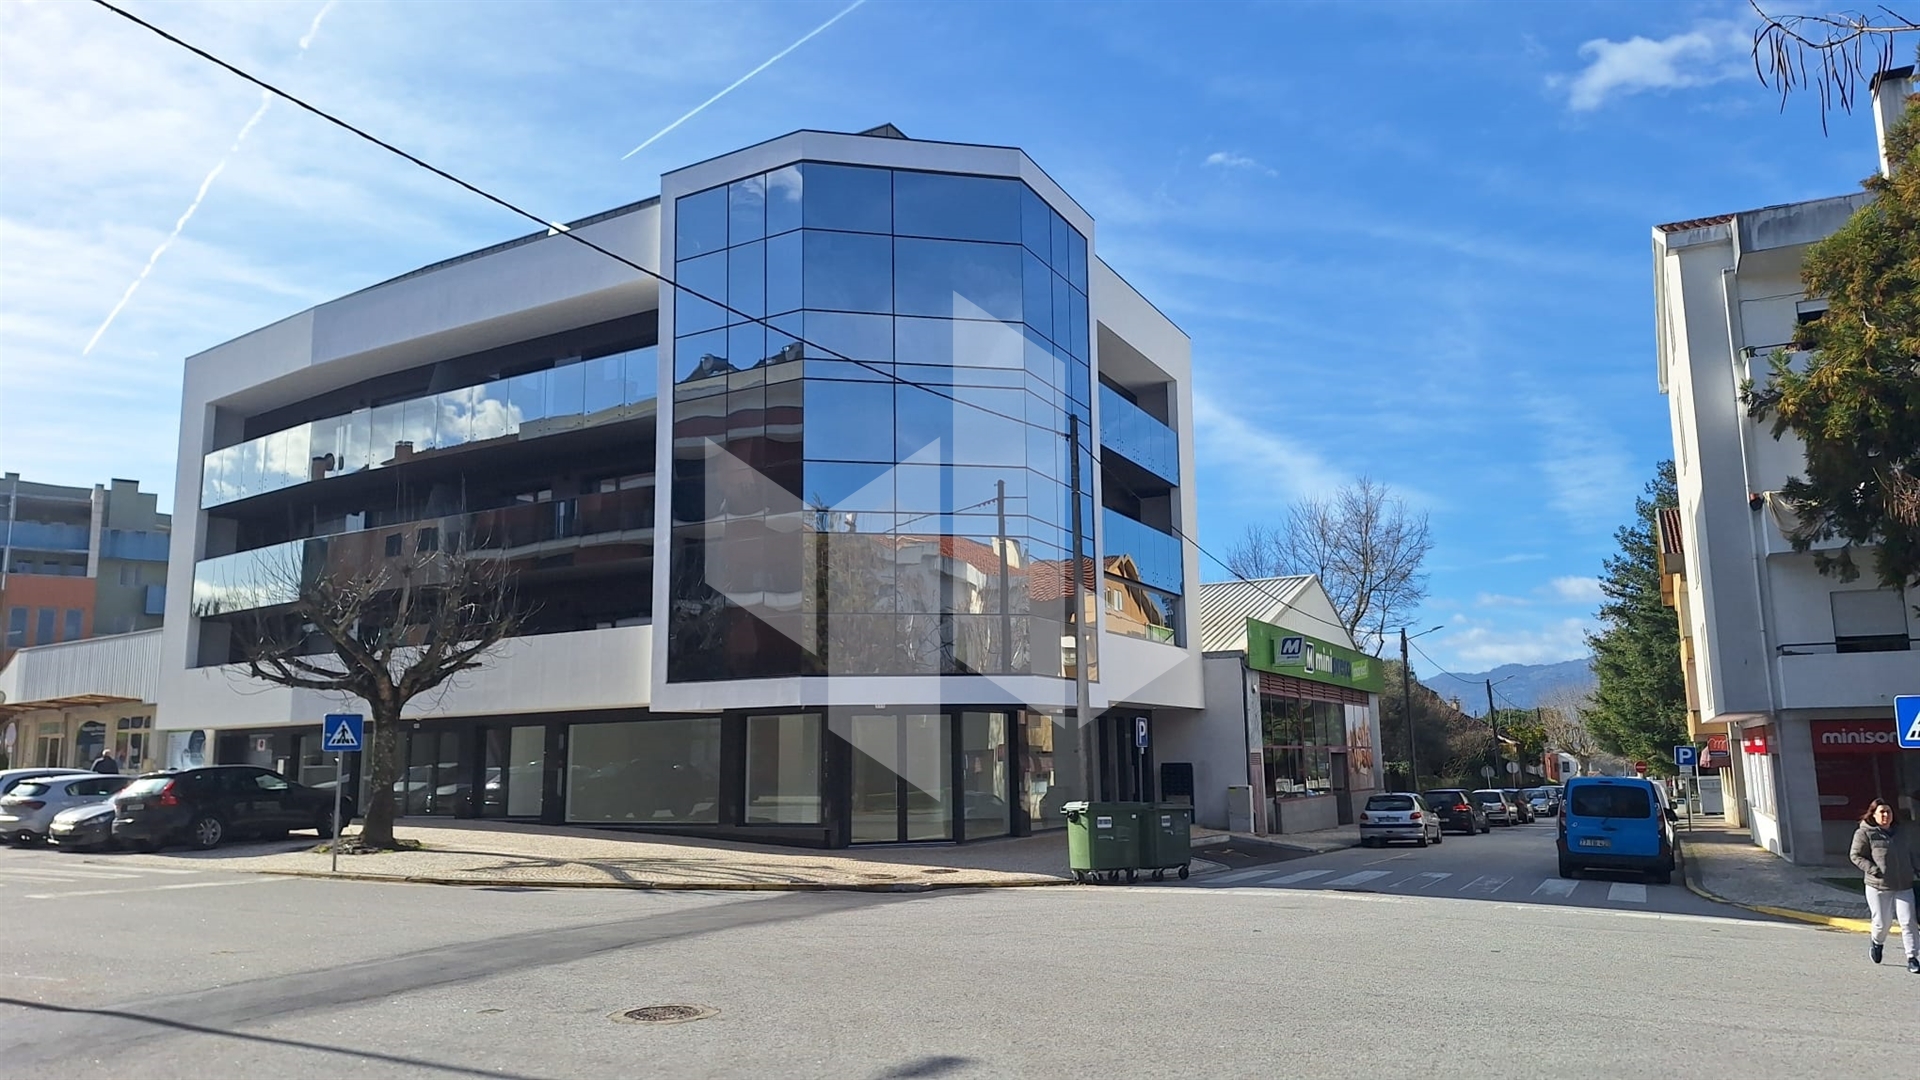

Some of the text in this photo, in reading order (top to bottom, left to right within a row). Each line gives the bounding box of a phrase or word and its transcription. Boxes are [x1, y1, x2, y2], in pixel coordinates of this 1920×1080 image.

[1283, 639, 1300, 653] M
[1139, 721, 1146, 744] P
[1679, 748, 1692, 763] P
